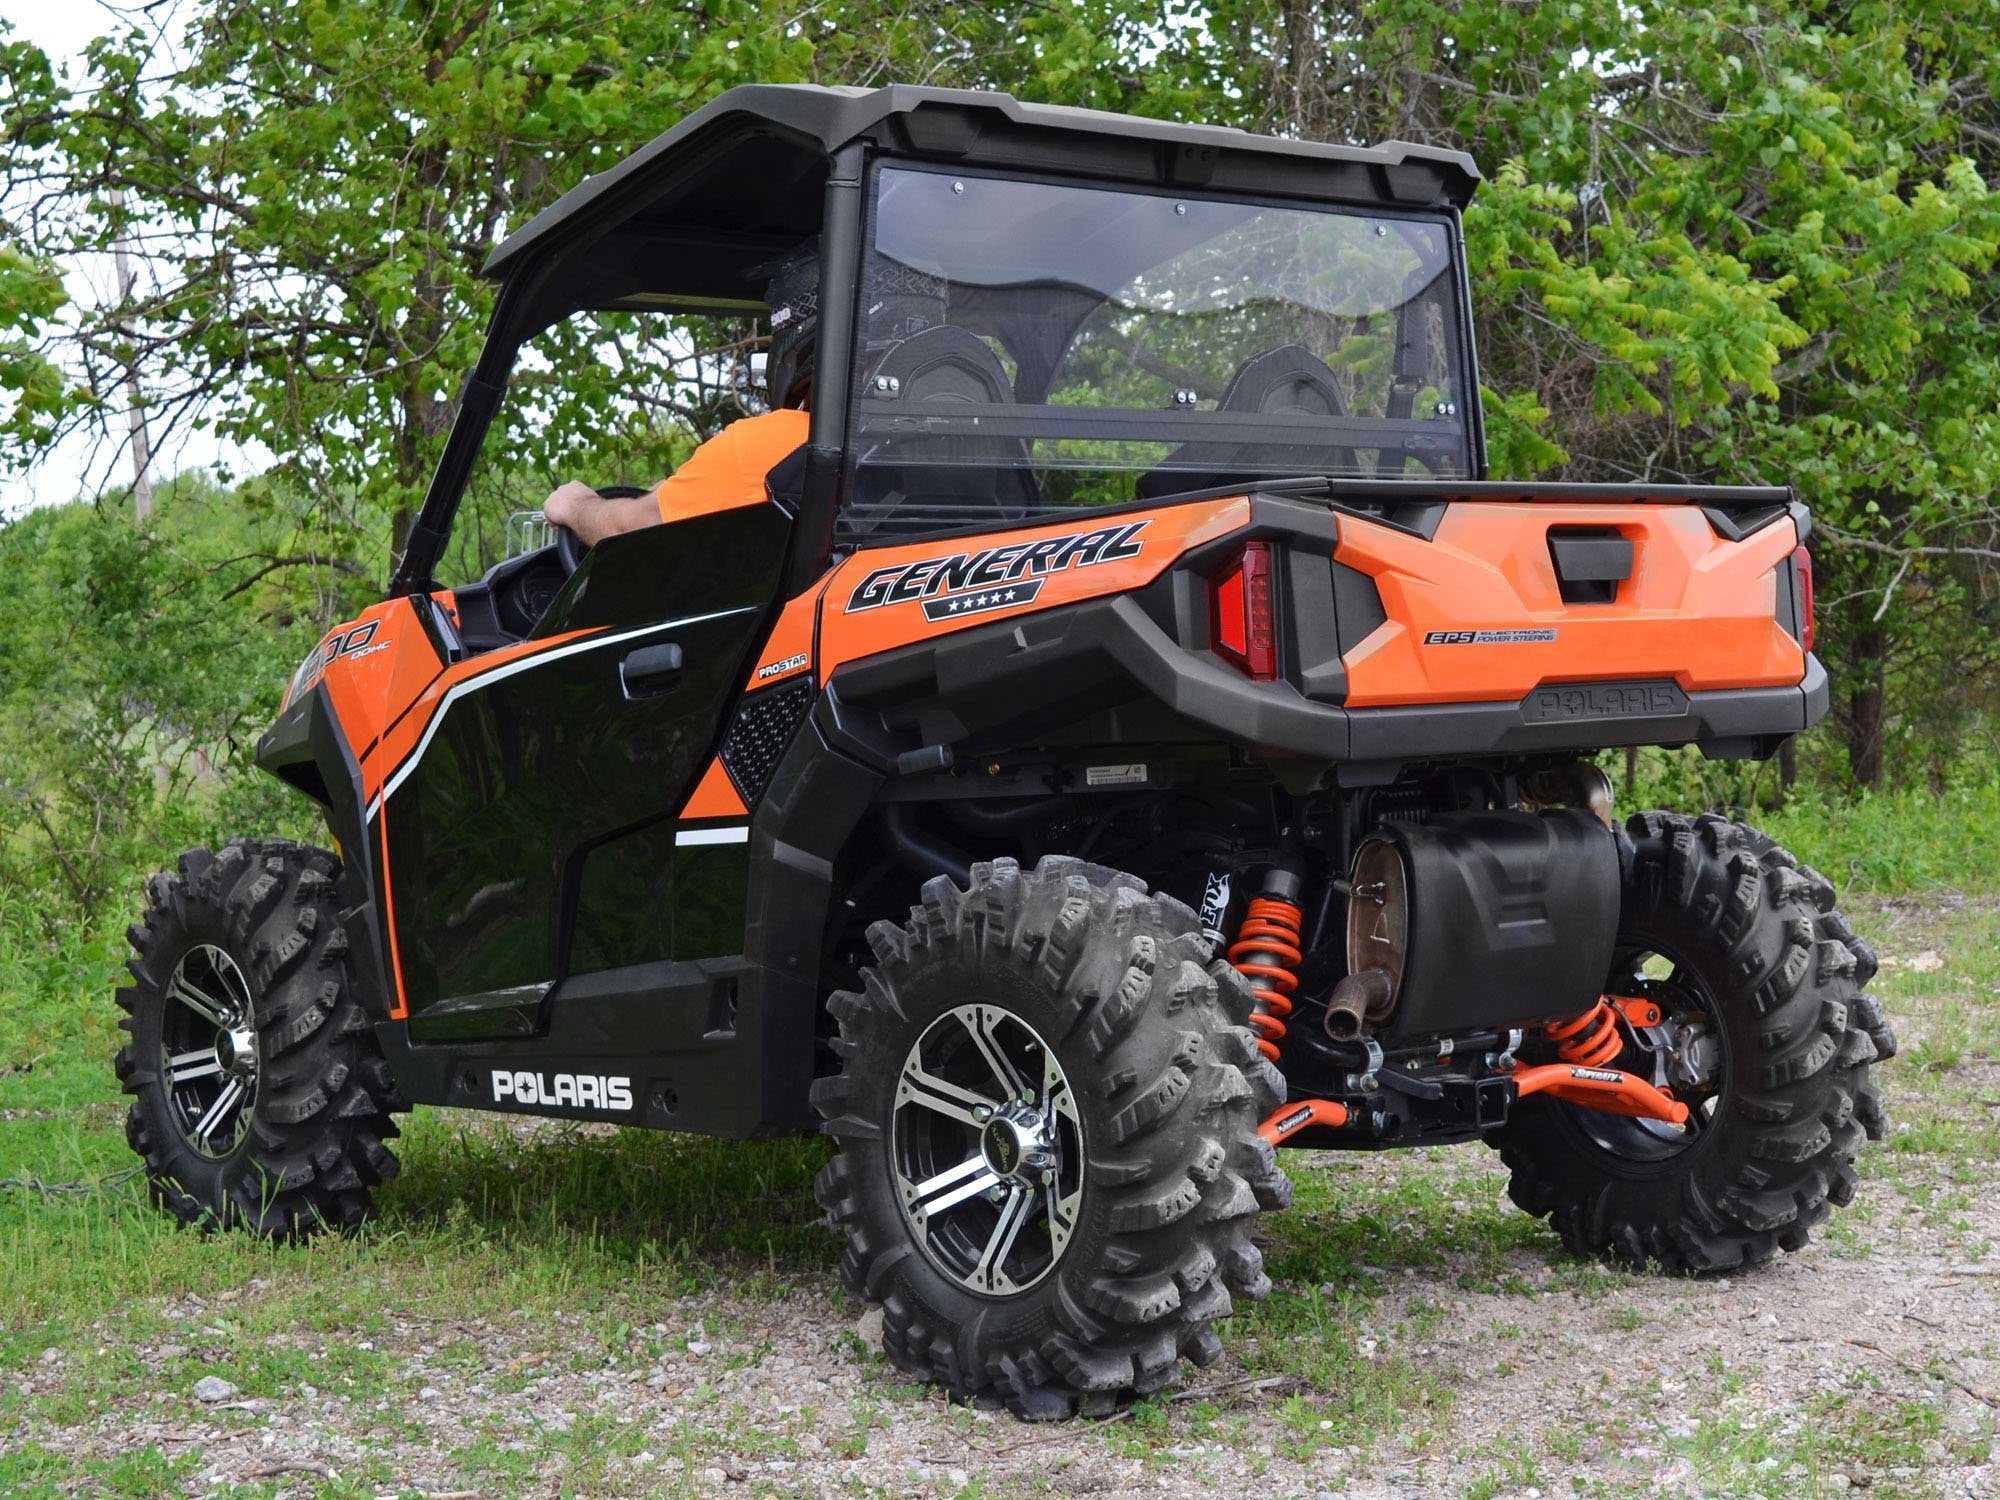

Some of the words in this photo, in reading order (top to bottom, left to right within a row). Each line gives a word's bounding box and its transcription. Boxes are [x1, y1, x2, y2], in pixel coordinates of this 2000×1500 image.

[845, 520, 1153, 614] GENERAL
[1429, 632, 1473, 643] EPS
[759, 653, 807, 679] PROSTAR
[1539, 687, 1675, 719] POLARIS
[1199, 872, 1230, 925] FOX
[491, 1070, 633, 1111] POLARIS
